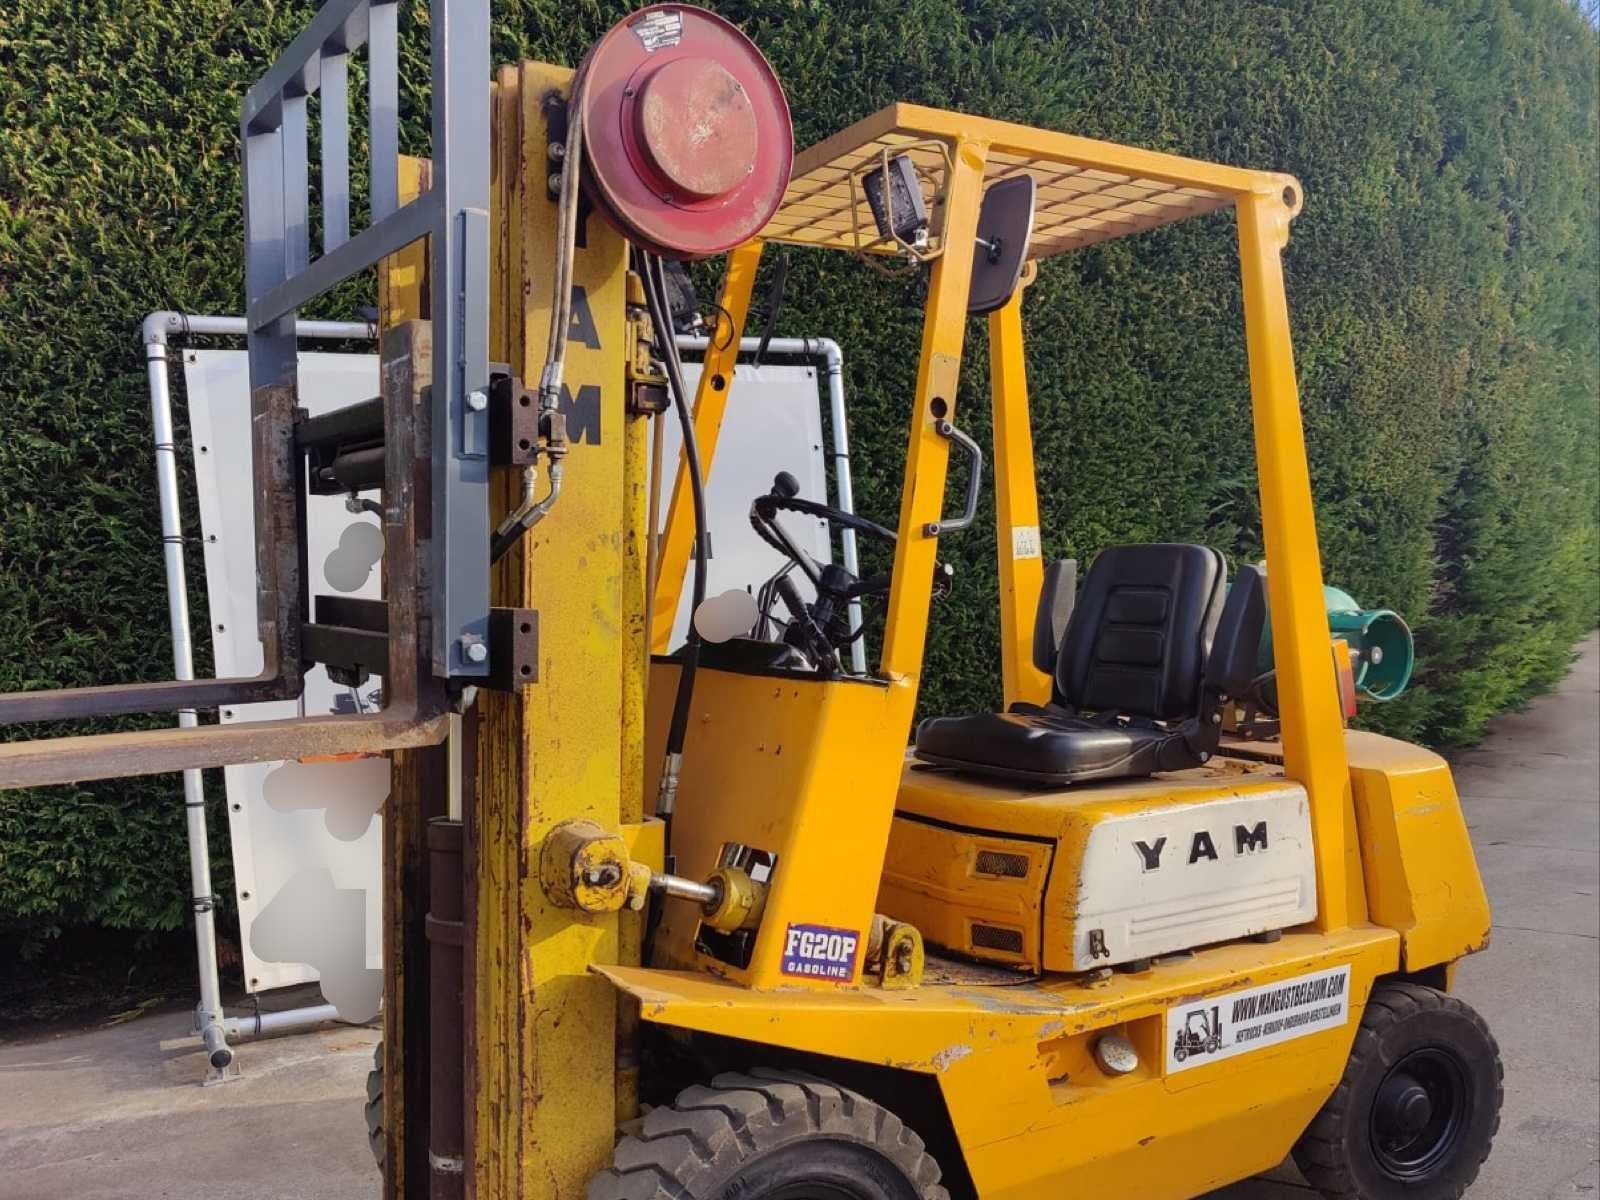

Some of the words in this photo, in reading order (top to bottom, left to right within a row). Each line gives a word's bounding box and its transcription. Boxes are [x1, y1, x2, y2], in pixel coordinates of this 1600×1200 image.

[1134, 821, 1268, 871] YAM
[784, 929, 857, 963] FG20P
[787, 961, 847, 978] GASOLINE
